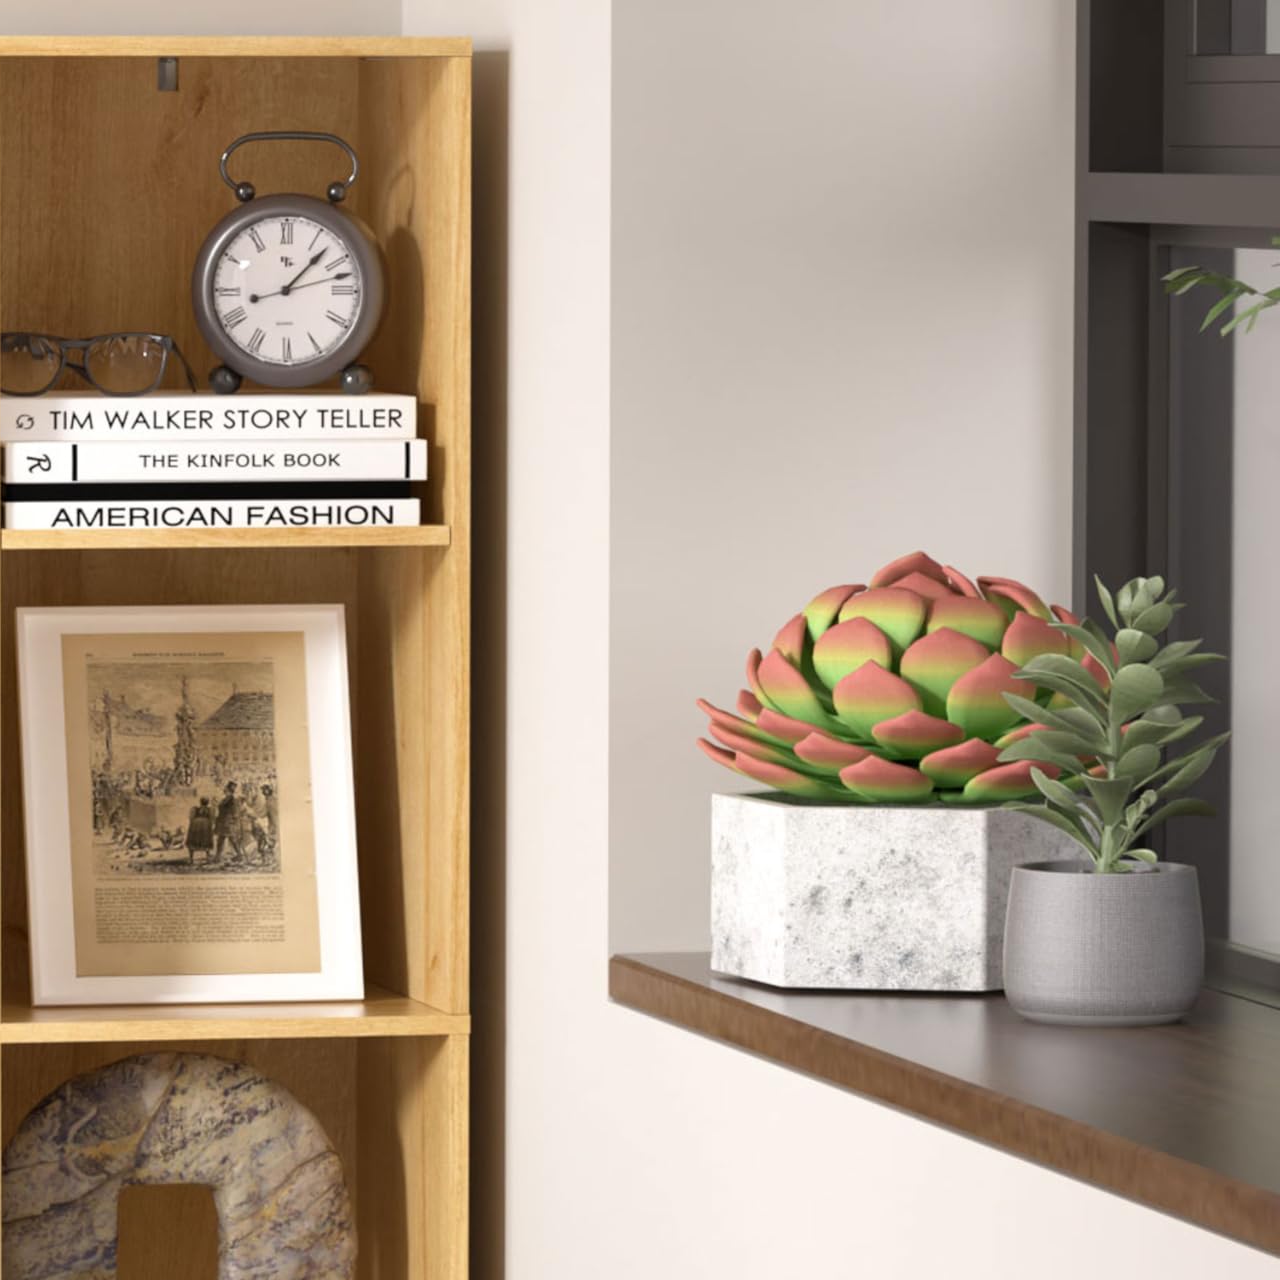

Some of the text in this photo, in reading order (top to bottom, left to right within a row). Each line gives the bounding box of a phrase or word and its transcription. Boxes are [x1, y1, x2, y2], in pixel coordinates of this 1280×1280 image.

[280, 222, 293, 244] XII
[49, 408, 403, 430] TIM WALKER STORY TELLER
[138, 453, 341, 469] THE KINFOLK BOOK
[51, 505, 394, 527] AMERICAN FASHION
